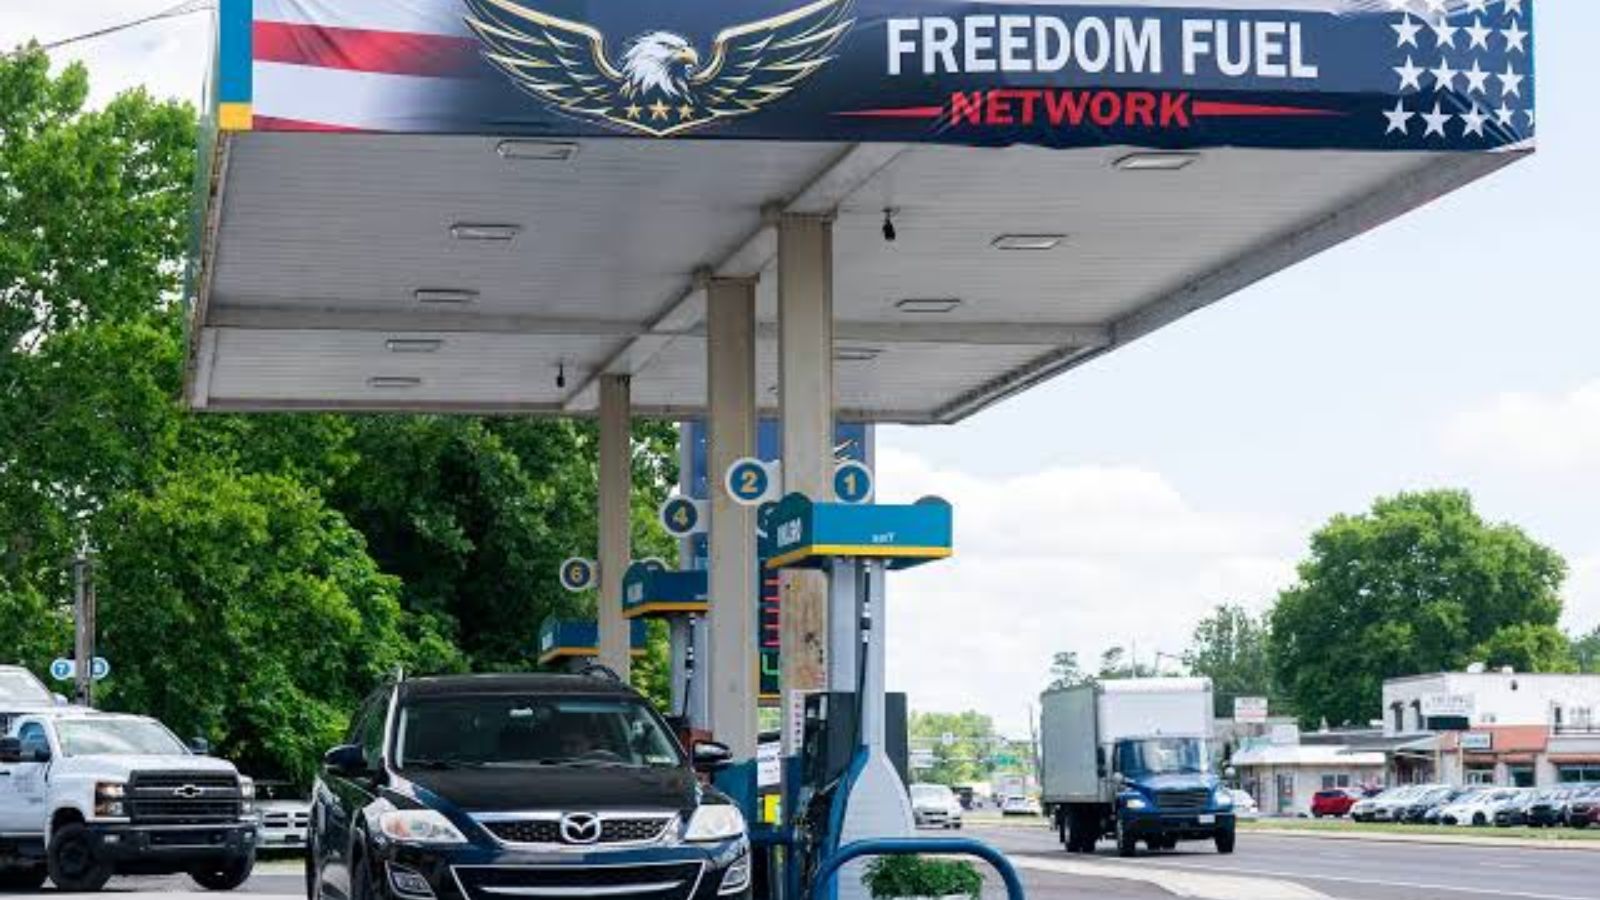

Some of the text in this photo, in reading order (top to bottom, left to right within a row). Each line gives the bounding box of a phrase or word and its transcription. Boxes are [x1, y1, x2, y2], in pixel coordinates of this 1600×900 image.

[887, 15, 1319, 78] FREEDOM FUEL
[951, 89, 1192, 128] NETWORK
[741, 471, 757, 493] 2
[844, 474, 857, 496] 1
[672, 506, 688, 525] 4
